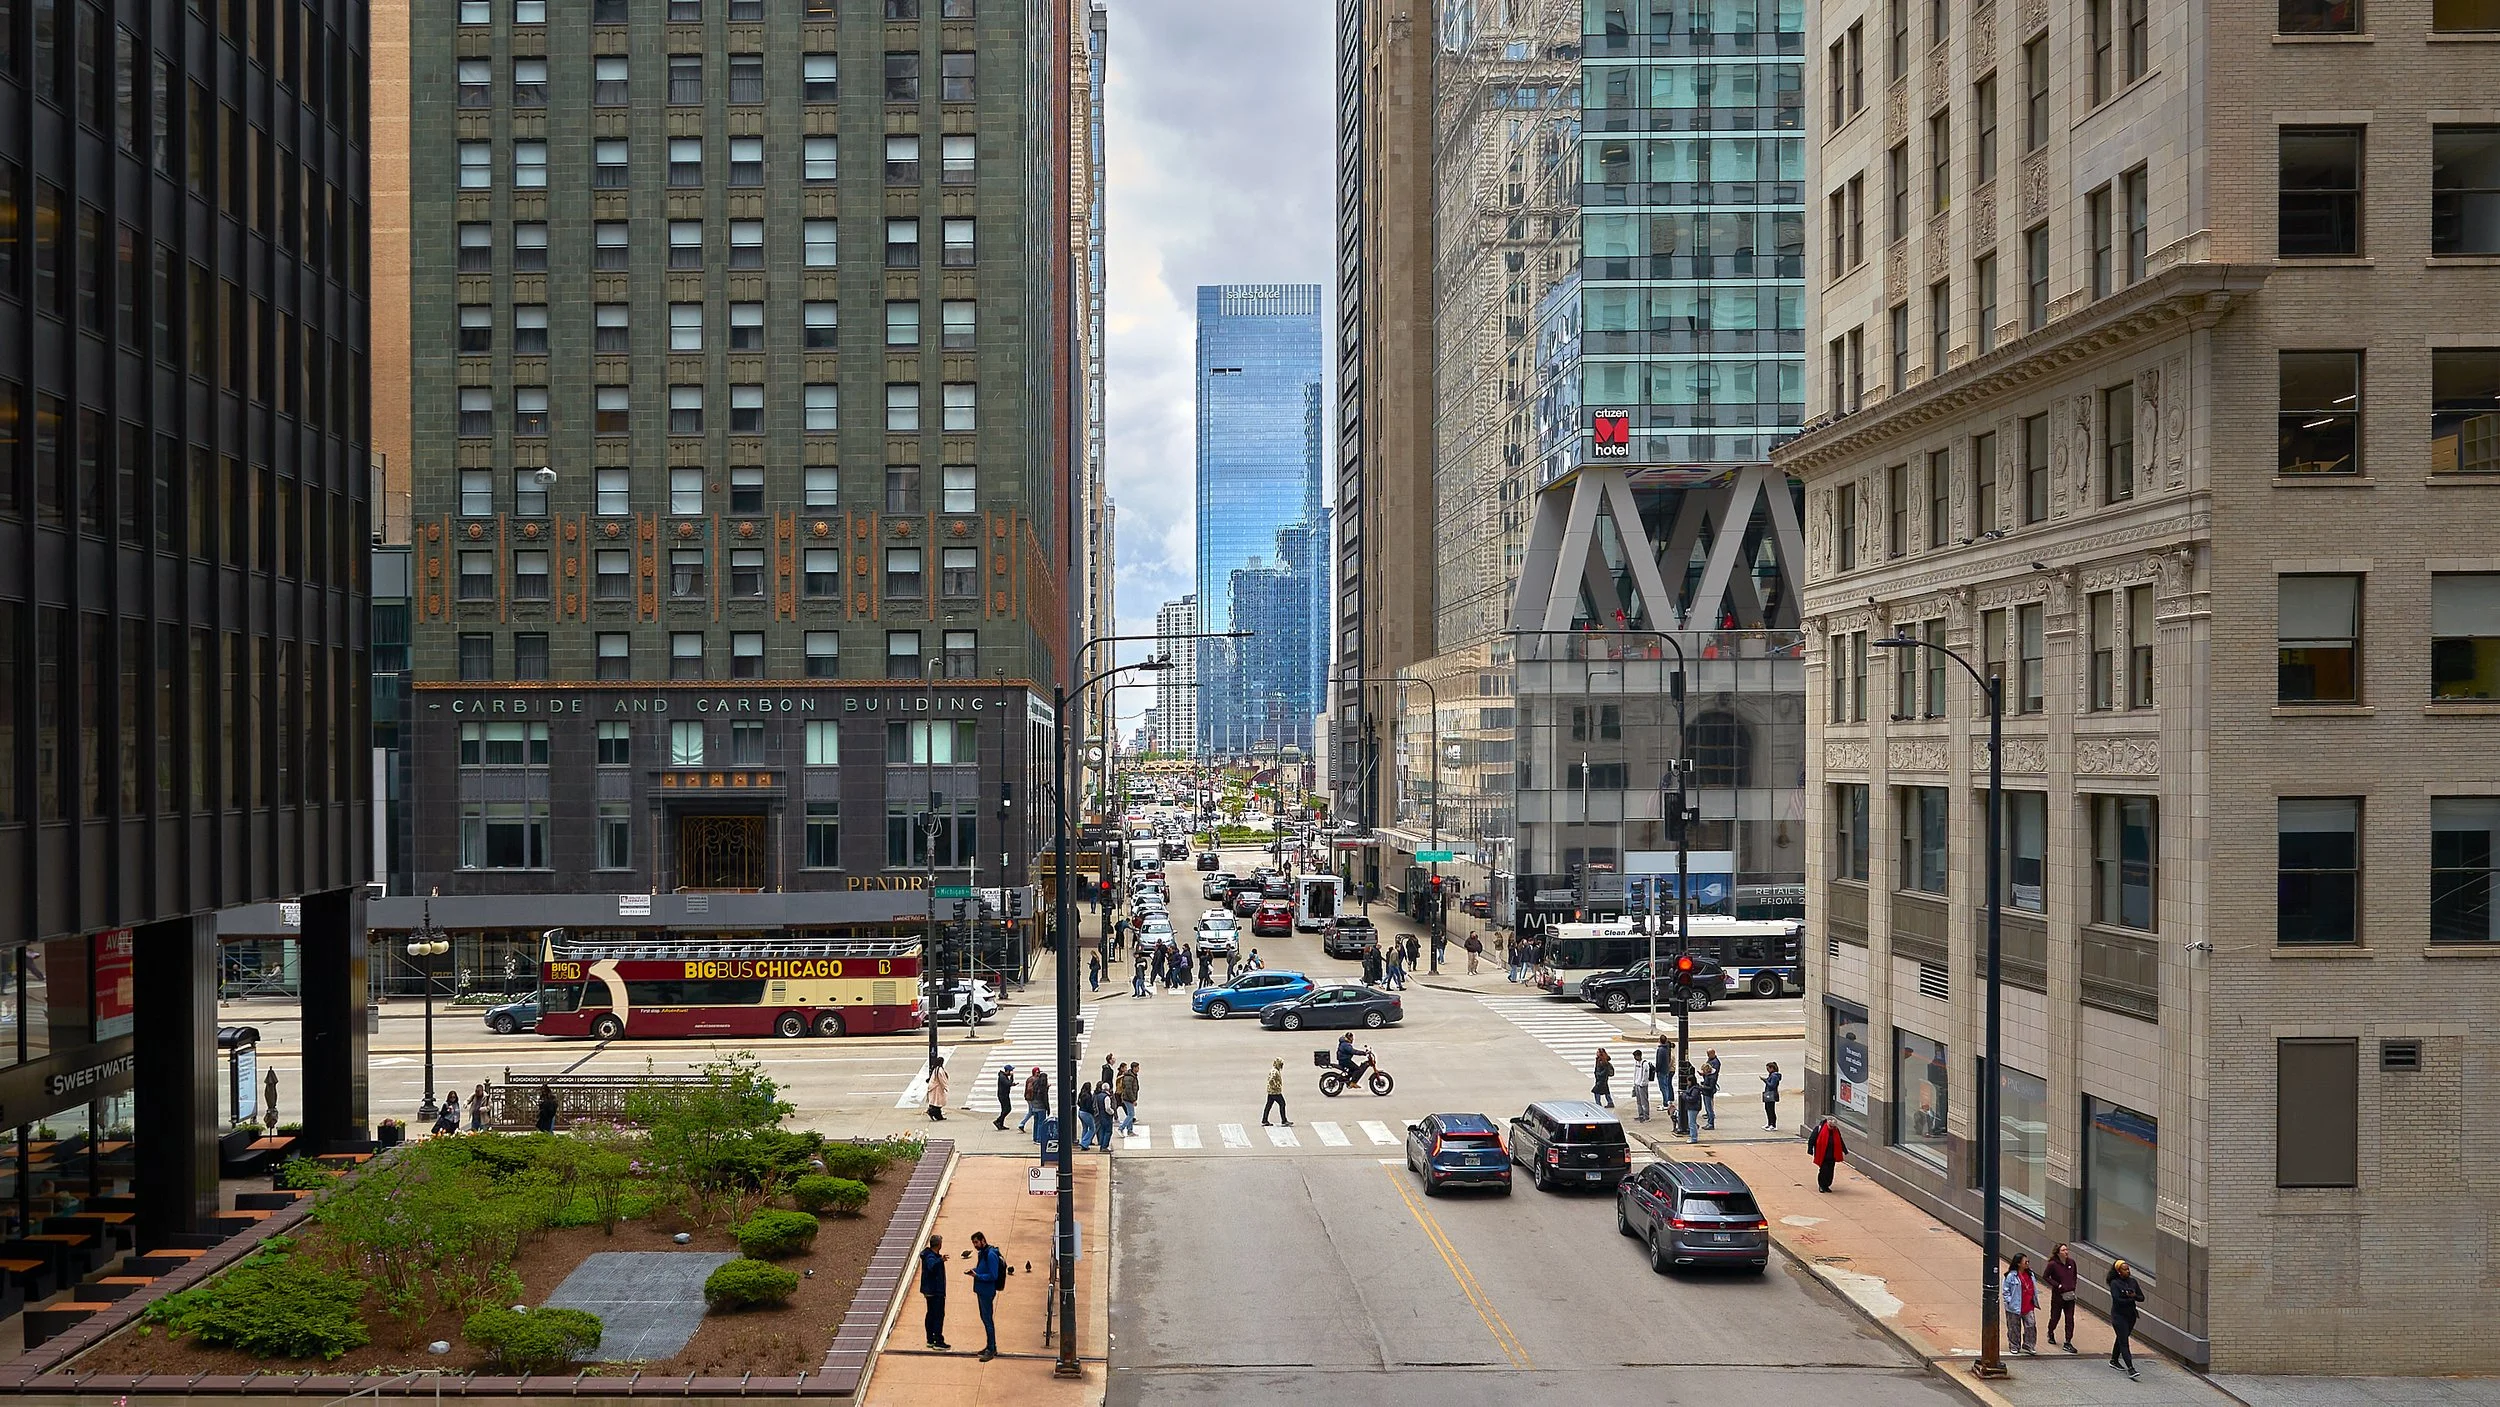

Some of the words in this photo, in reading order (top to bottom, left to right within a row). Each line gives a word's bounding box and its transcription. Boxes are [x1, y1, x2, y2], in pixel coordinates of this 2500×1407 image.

[1227, 288, 1280, 302] salesforce
[1595, 408, 1629, 418] citizen
[1595, 443, 1629, 456] hotel
[452, 699, 582, 713] CARBIDE
[614, 699, 668, 713] AND
[696, 698, 815, 712] CARBON
[844, 697, 984, 711] BUILDING
[941, 887, 965, 897] Michigan
[552, 963, 568, 972] BIG
[755, 960, 843, 978] CHICAGO
[552, 972, 568, 980] BUS
[53, 1054, 134, 1096] SWEETWATE
[2007, 1078, 2019, 1093] PNC
